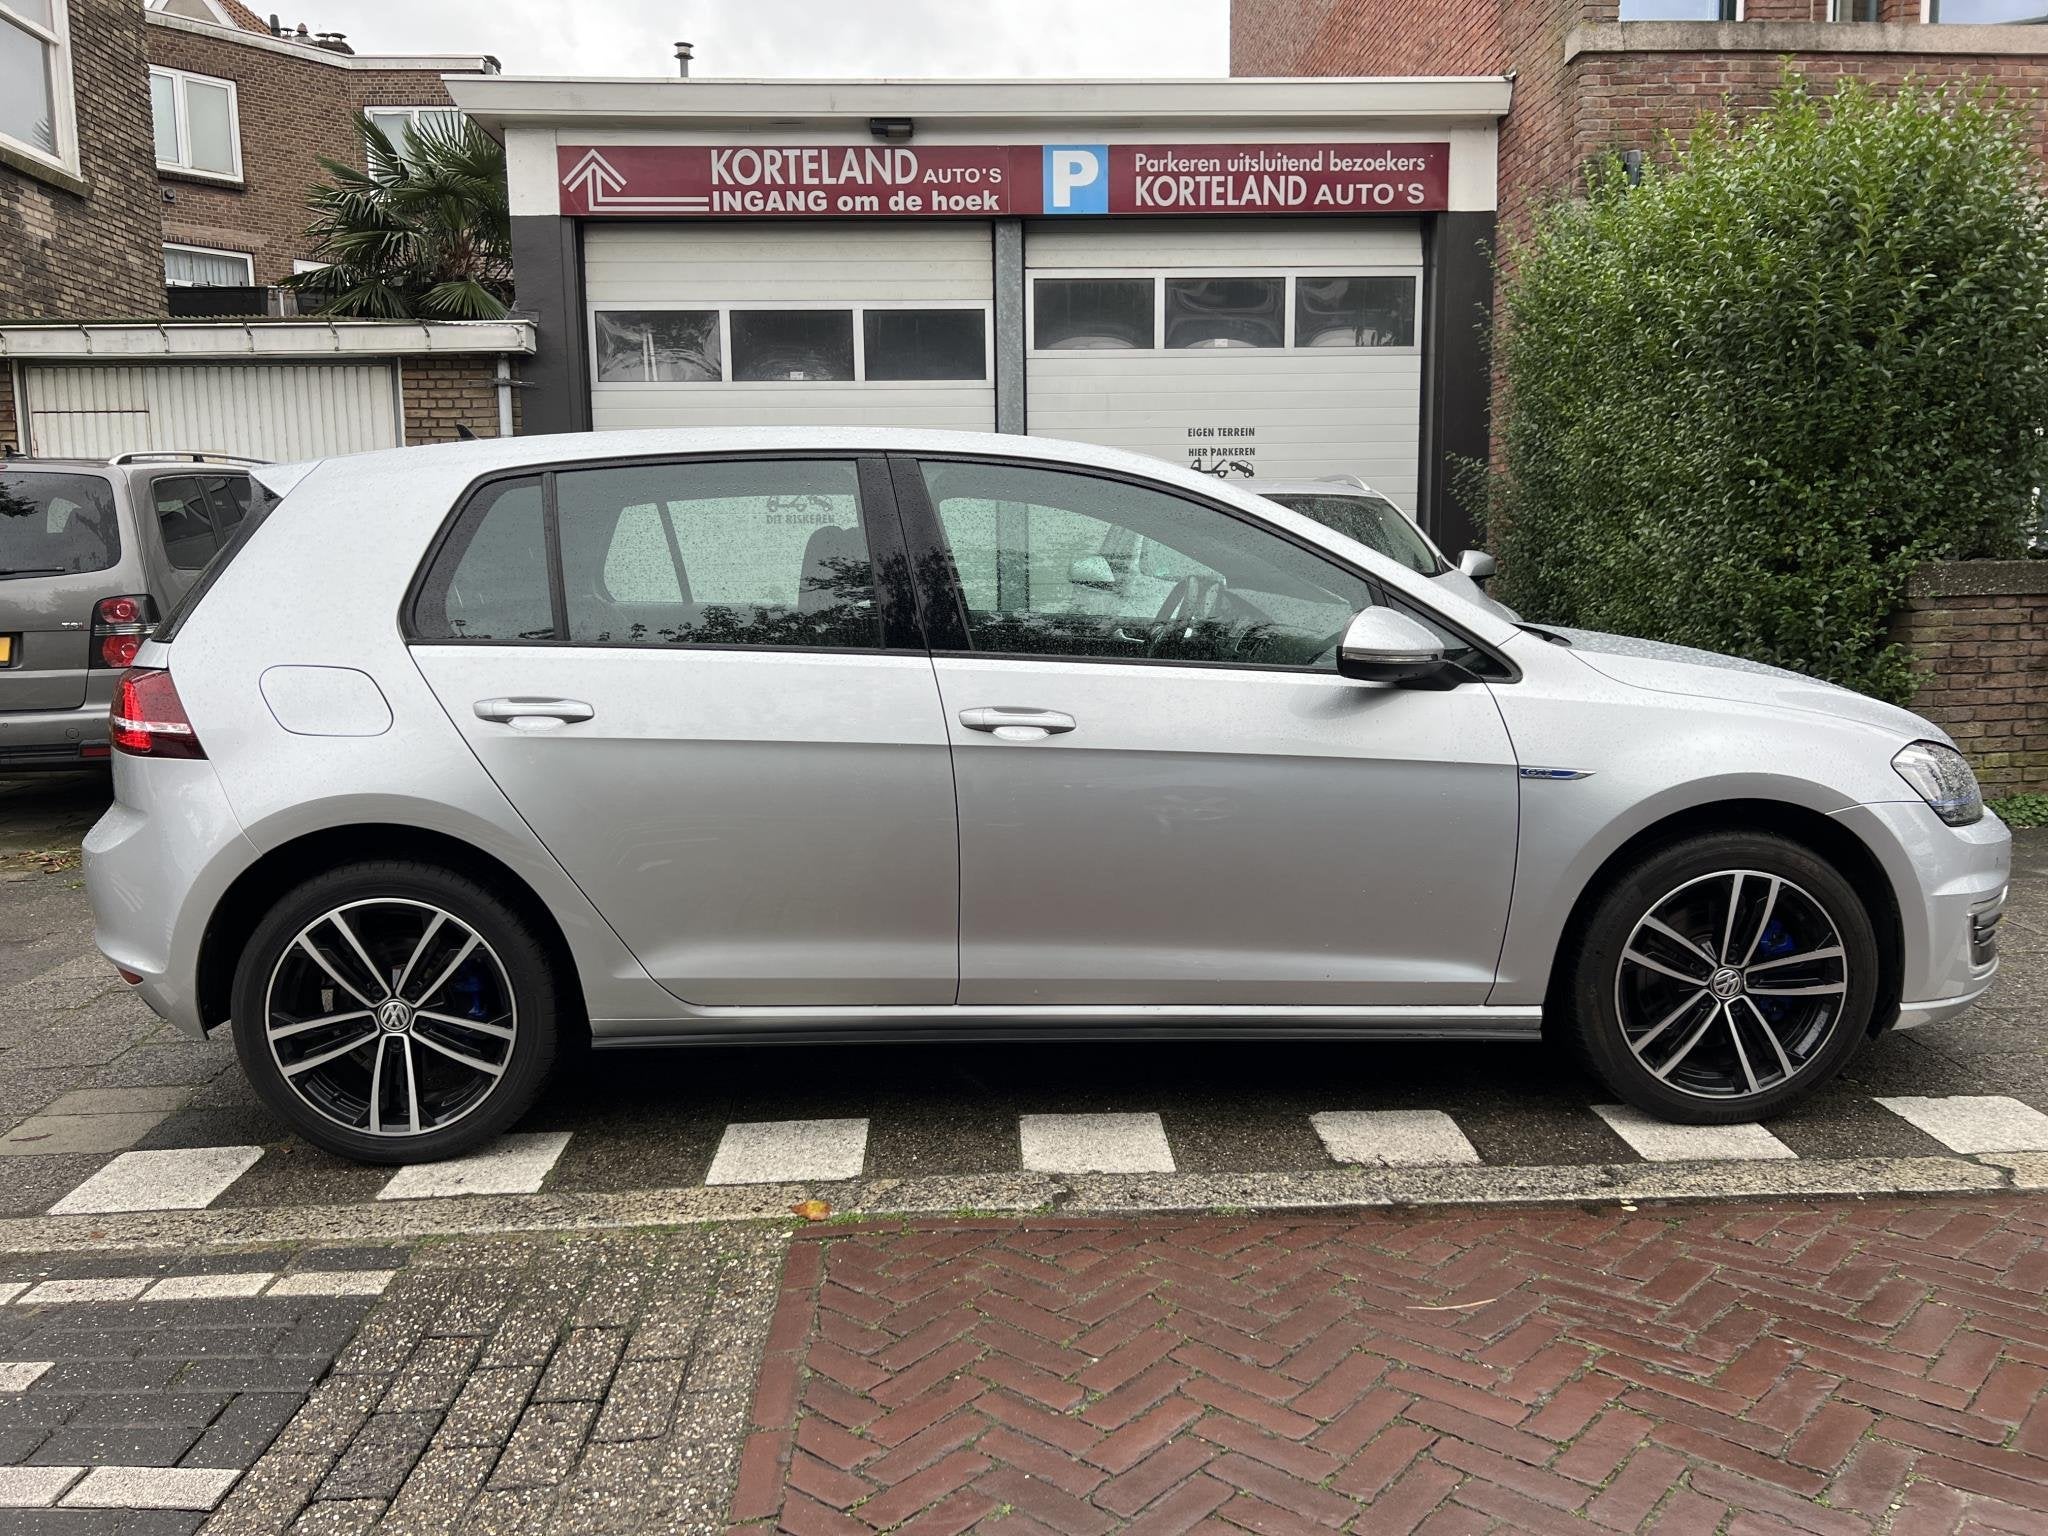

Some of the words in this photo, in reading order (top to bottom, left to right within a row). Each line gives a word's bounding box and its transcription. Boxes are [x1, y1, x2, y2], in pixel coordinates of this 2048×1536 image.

[711, 148, 918, 186] KORTELAND
[923, 167, 1002, 184] AUTO'S
[1135, 153, 1220, 173] Parkeren
[1228, 151, 1323, 173] uitsluitend
[1330, 150, 1426, 172] bezoekers
[1052, 150, 1099, 208] P
[713, 191, 828, 212] INGANG
[837, 196, 880, 212] om
[888, 191, 923, 212] de
[932, 190, 1000, 212] hoek
[1135, 175, 1307, 207] KORTELAND
[1314, 183, 1425, 206] AUTO'S
[1187, 428, 1214, 437] EIGEN
[1218, 427, 1255, 437] TERREIN
[1188, 448, 1208, 456] HIER
[1211, 447, 1256, 456] PARKEREN
